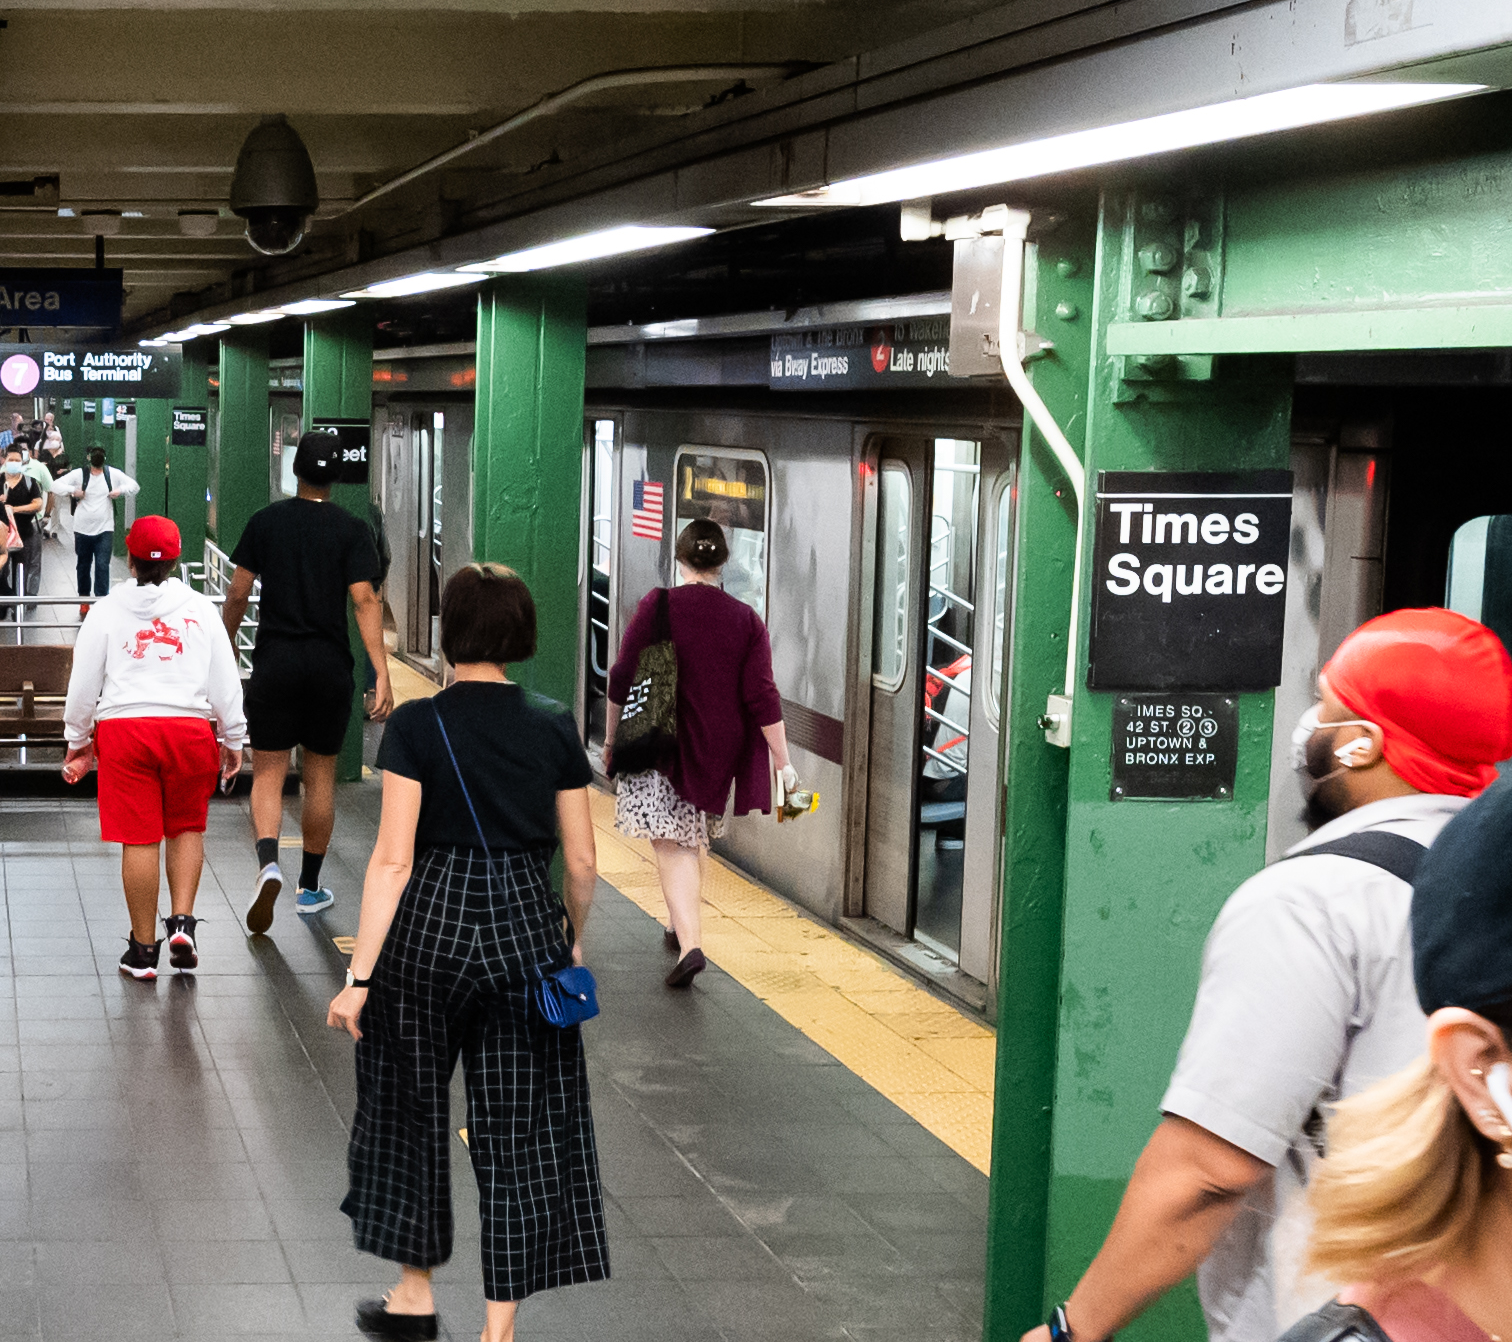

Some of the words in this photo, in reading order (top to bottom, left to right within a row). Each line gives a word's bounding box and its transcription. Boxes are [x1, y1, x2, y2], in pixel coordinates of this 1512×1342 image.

[43, 351, 76, 367] Port
[82, 352, 153, 370] Authority
[771, 352, 783, 378] via
[811, 353, 849, 380] Express
[890, 347, 914, 372] Late
[917, 346, 950, 378] nights
[43, 366, 74, 381] Bus
[80, 366, 143, 381] Terminal
[173, 411, 201, 422] Times
[173, 421, 206, 432] Square
[342, 445, 367, 462] eet
[1109, 503, 1260, 546] Times
[1105, 553, 1286, 604] Square
[1126, 720, 1144, 733] 42
[1149, 720, 1172, 733] ST.
[1126, 736, 1193, 749] UPTOWN
[1198, 737, 1208, 749] &
[1125, 752, 1179, 765] BRONX
